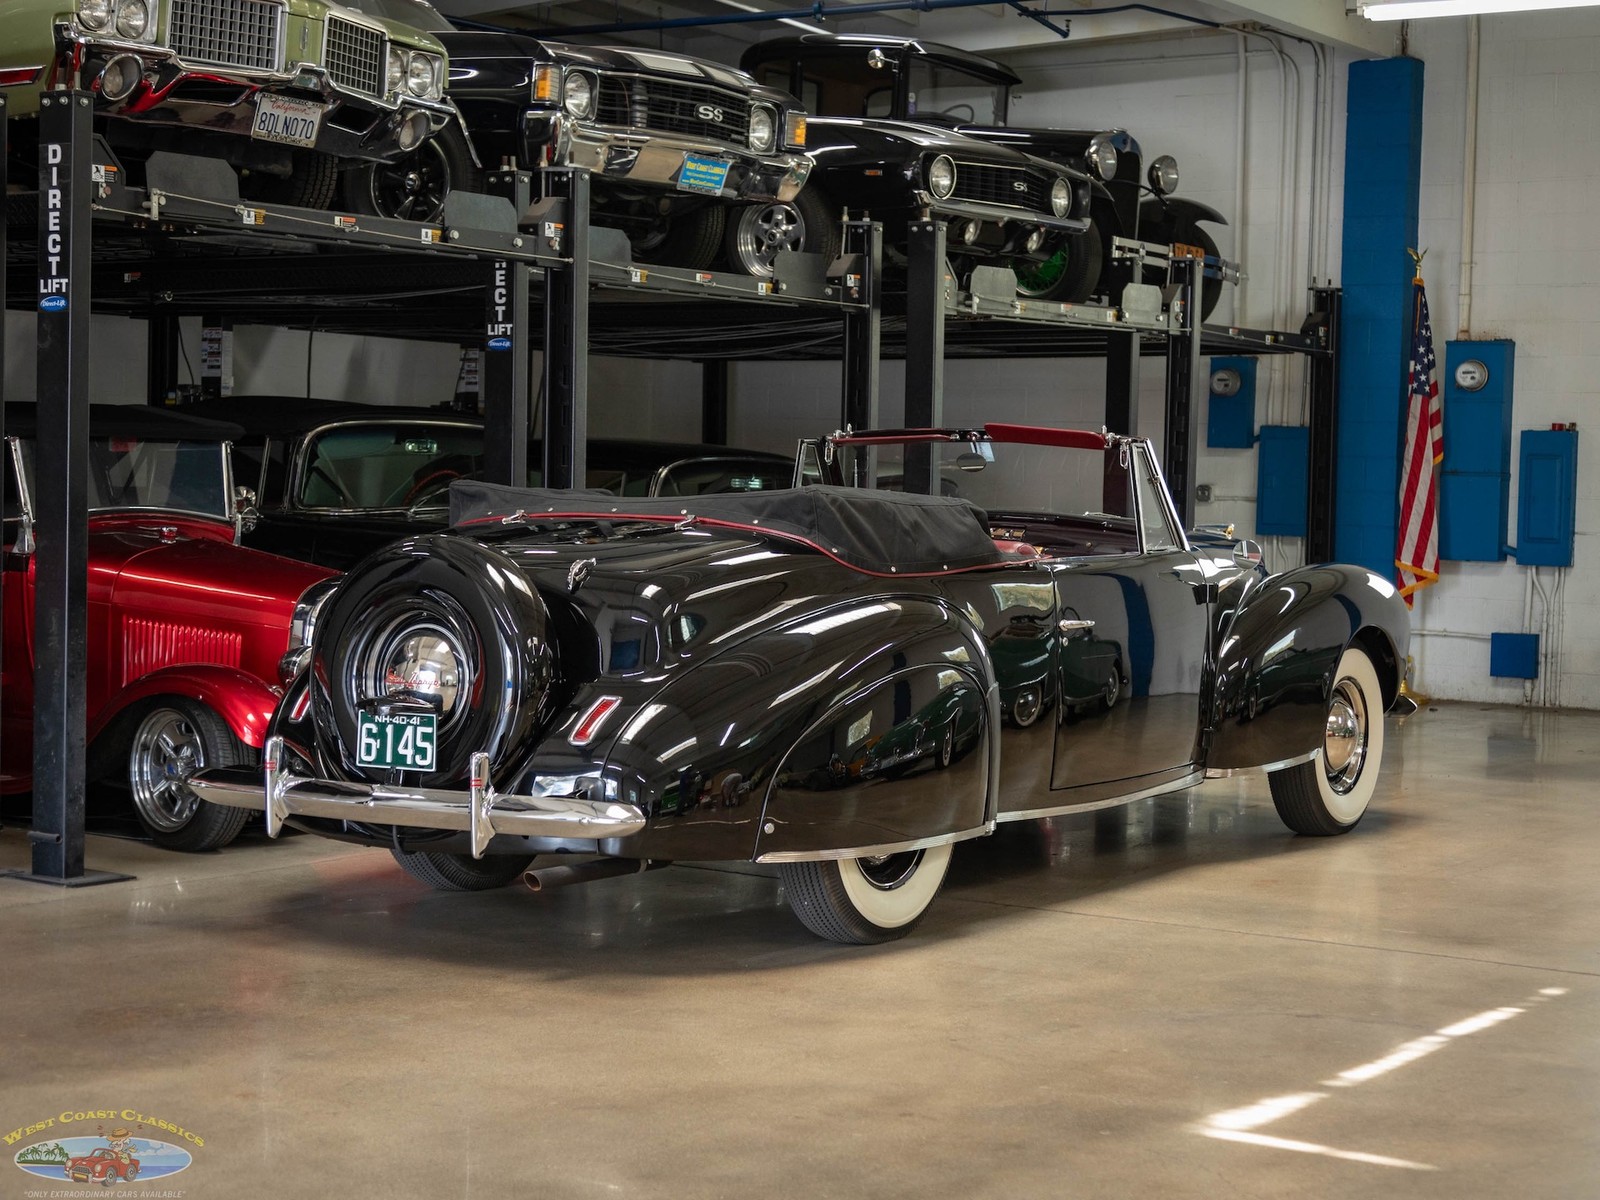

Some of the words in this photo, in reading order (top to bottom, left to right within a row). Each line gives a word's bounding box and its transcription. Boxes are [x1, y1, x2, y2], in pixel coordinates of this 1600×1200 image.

[258, 111, 315, 140] 8DLN070
[47, 144, 62, 276] DIRECT
[39, 278, 69, 293] LIFT
[487, 323, 513, 336] LIFT
